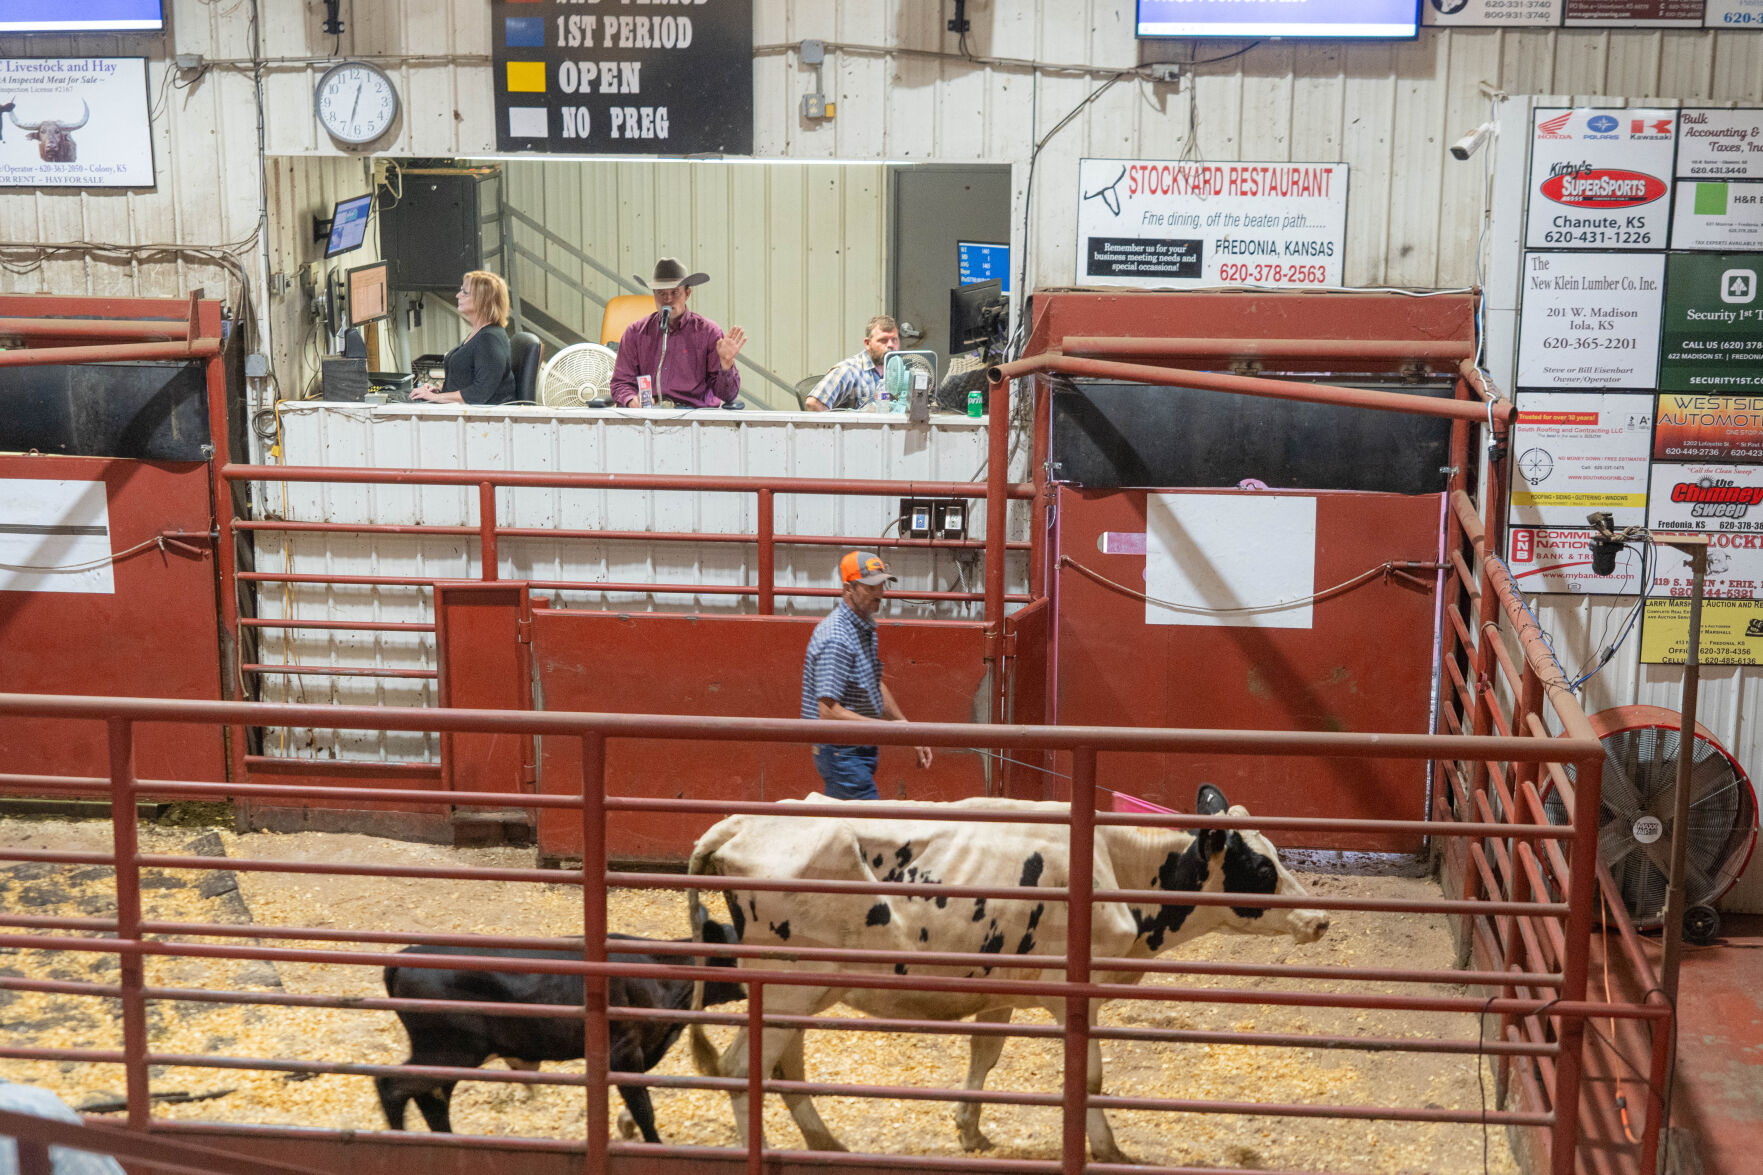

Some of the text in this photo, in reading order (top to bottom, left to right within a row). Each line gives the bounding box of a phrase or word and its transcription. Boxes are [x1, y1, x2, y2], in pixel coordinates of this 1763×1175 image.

[557, 15, 692, 49] 1ST PERIOD
[7, 60, 117, 75] Livestock and Hay
[339, 73, 345, 84] 11
[351, 68, 360, 79] 12
[558, 62, 642, 94] OPEN
[9, 76, 44, 85] Inspected
[67, 76, 79, 85] for
[329, 84, 339, 94] 10
[375, 82, 382, 93] 2
[324, 97, 331, 108] 9
[381, 96, 388, 107] 3
[330, 111, 336, 121] 8
[377, 110, 383, 120] 4
[1682, 113, 1708, 124] Bulk
[340, 121, 347, 131] 7
[368, 121, 374, 131] 5
[561, 106, 670, 139] NO PREG
[354, 125, 361, 135] 6
[1685, 127, 1760, 141] Accounting &
[1709, 142, 1744, 153] Taxes,
[1550, 160, 1592, 179] Kirby's
[1129, 165, 1333, 197] STOCKYARD RESTAURANT
[1142, 211, 1279, 229] Fine dining, off the beaten
[1553, 215, 1645, 229] Chanute, KS
[1545, 231, 1651, 243] 620-431-1226
[1104, 243, 1144, 252] Remember
[1156, 244, 1166, 252] for
[1215, 239, 1334, 257] FREDONIA, KANSAS
[1094, 252, 1126, 261] business
[1128, 254, 1157, 263] meeting
[1182, 254, 1196, 262] and
[1531, 256, 1550, 270] The
[1112, 262, 1137, 271] special
[1220, 264, 1326, 283] 620-378-2563
[1531, 276, 1657, 290] New Klein Lumber Co. Inc.
[1547, 308, 1638, 318] 201 W. Madison
[1687, 309, 1736, 324] Security
[1740, 310, 1752, 320] 1st
[1570, 320, 1614, 330] Iola, KS
[1543, 338, 1636, 350] 620-365-2201
[1671, 483, 1763, 505] Chimney
[1729, 580, 1757, 589] ERIE,
